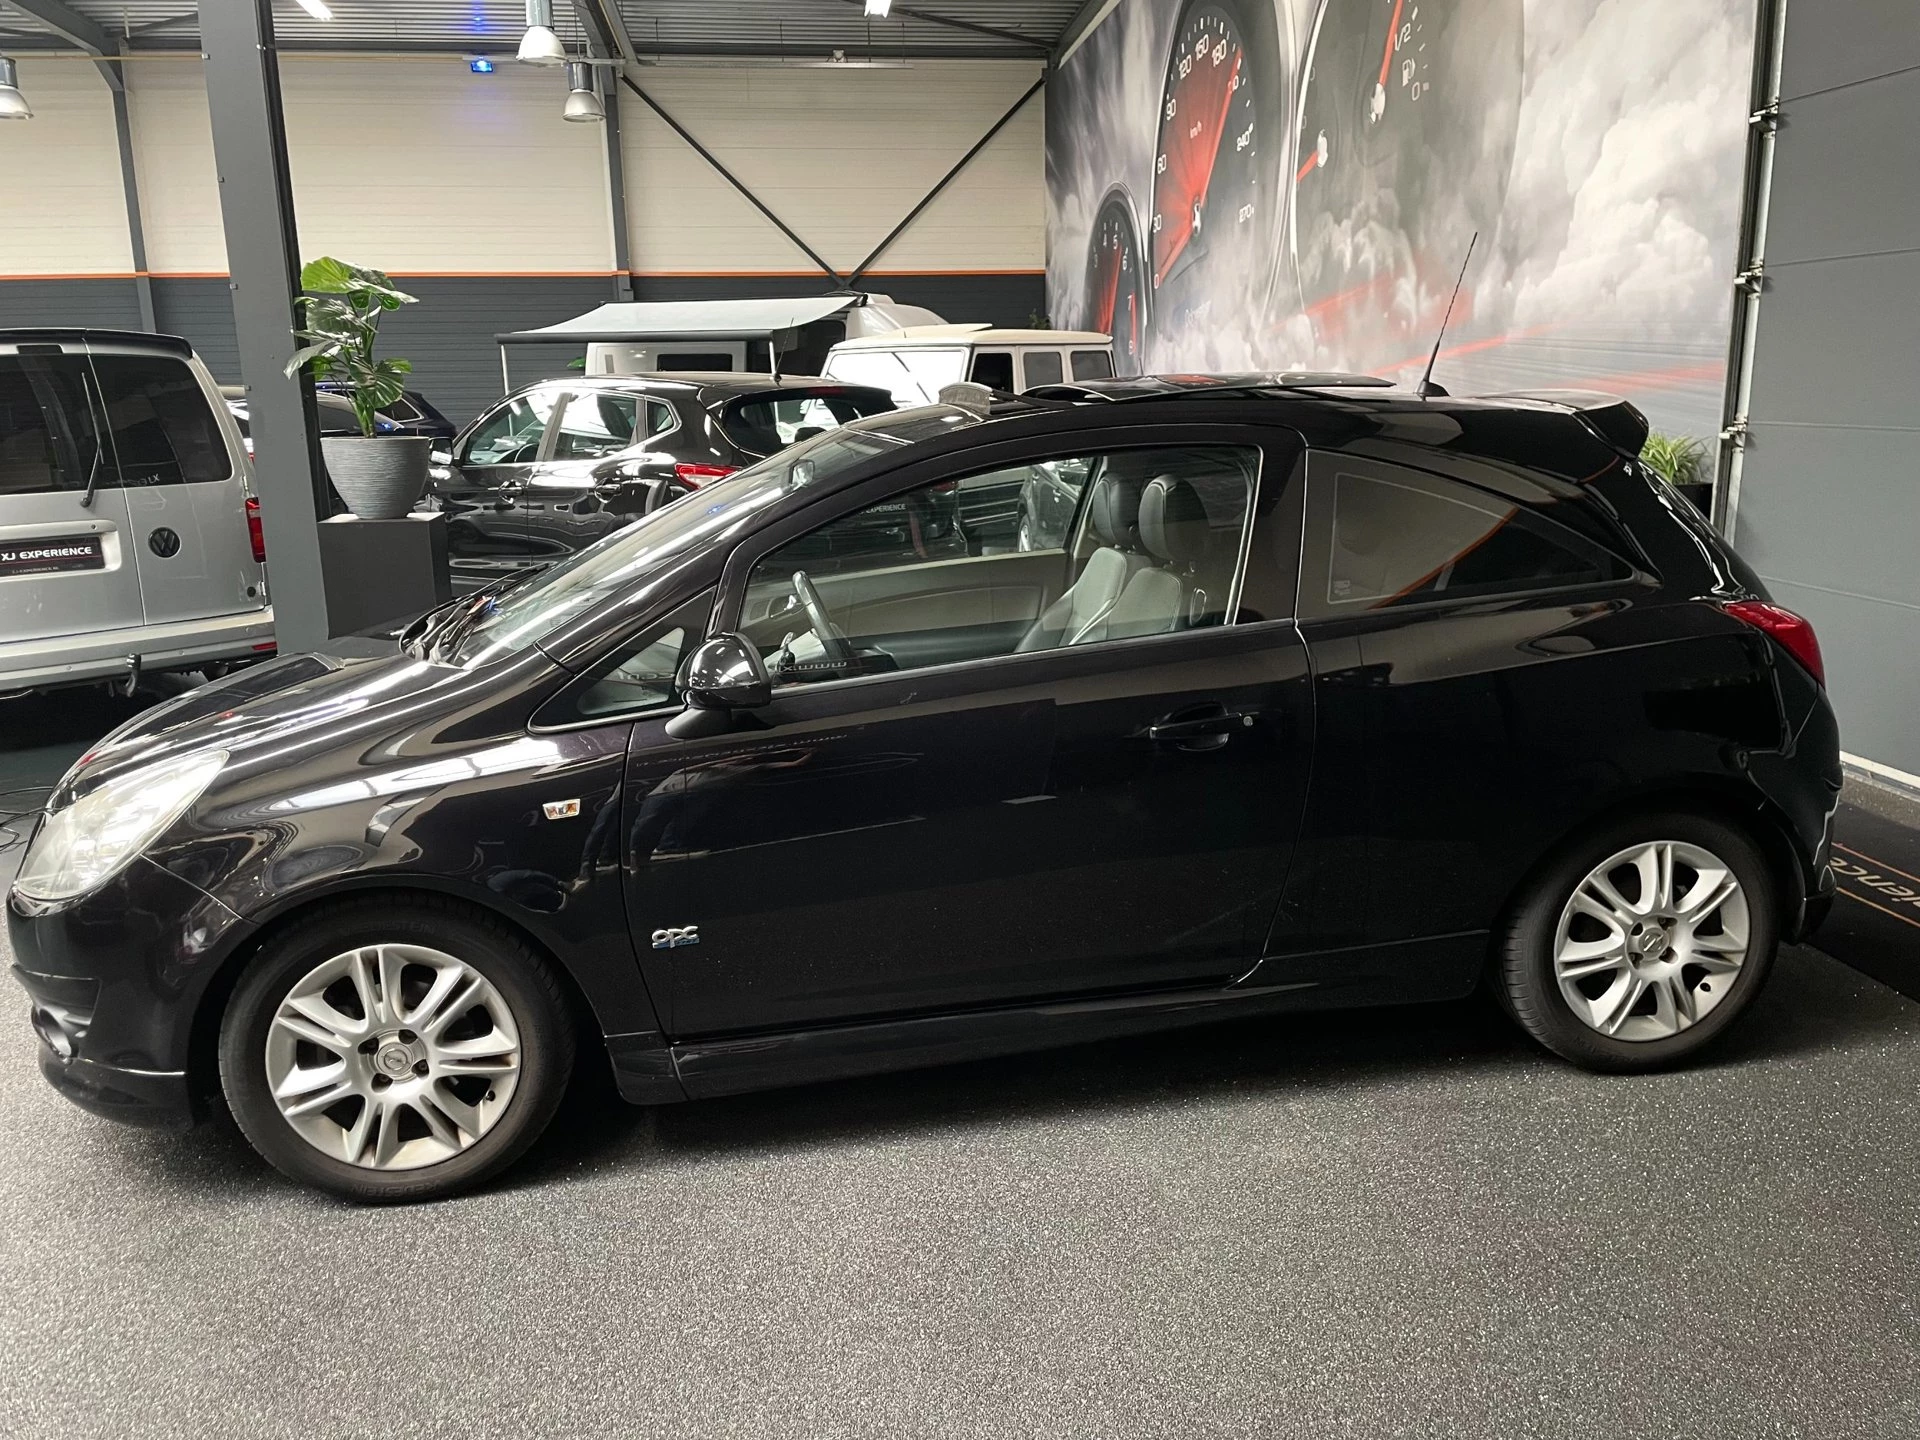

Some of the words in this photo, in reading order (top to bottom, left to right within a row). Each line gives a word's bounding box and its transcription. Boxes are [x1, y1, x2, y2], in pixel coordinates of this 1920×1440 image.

[1211, 38, 1226, 67] 180
[1178, 54, 1192, 80] 120
[1412, 81, 1420, 101] 0
[1166, 98, 1176, 120] 90
[1236, 130, 1250, 151] 240
[1157, 153, 1167, 174] 60
[1152, 213, 1162, 233] 30
[1239, 203, 1251, 223] 270
[1112, 233, 1118, 250] 5
[1122, 254, 1128, 270] 6
[1153, 273, 1160, 289] 0
[866, 503, 907, 514] PERIENCE
[1, 552, 16, 562] XJ
[19, 546, 93, 560] EXPERIENCE
[651, 925, 699, 949] OPC
